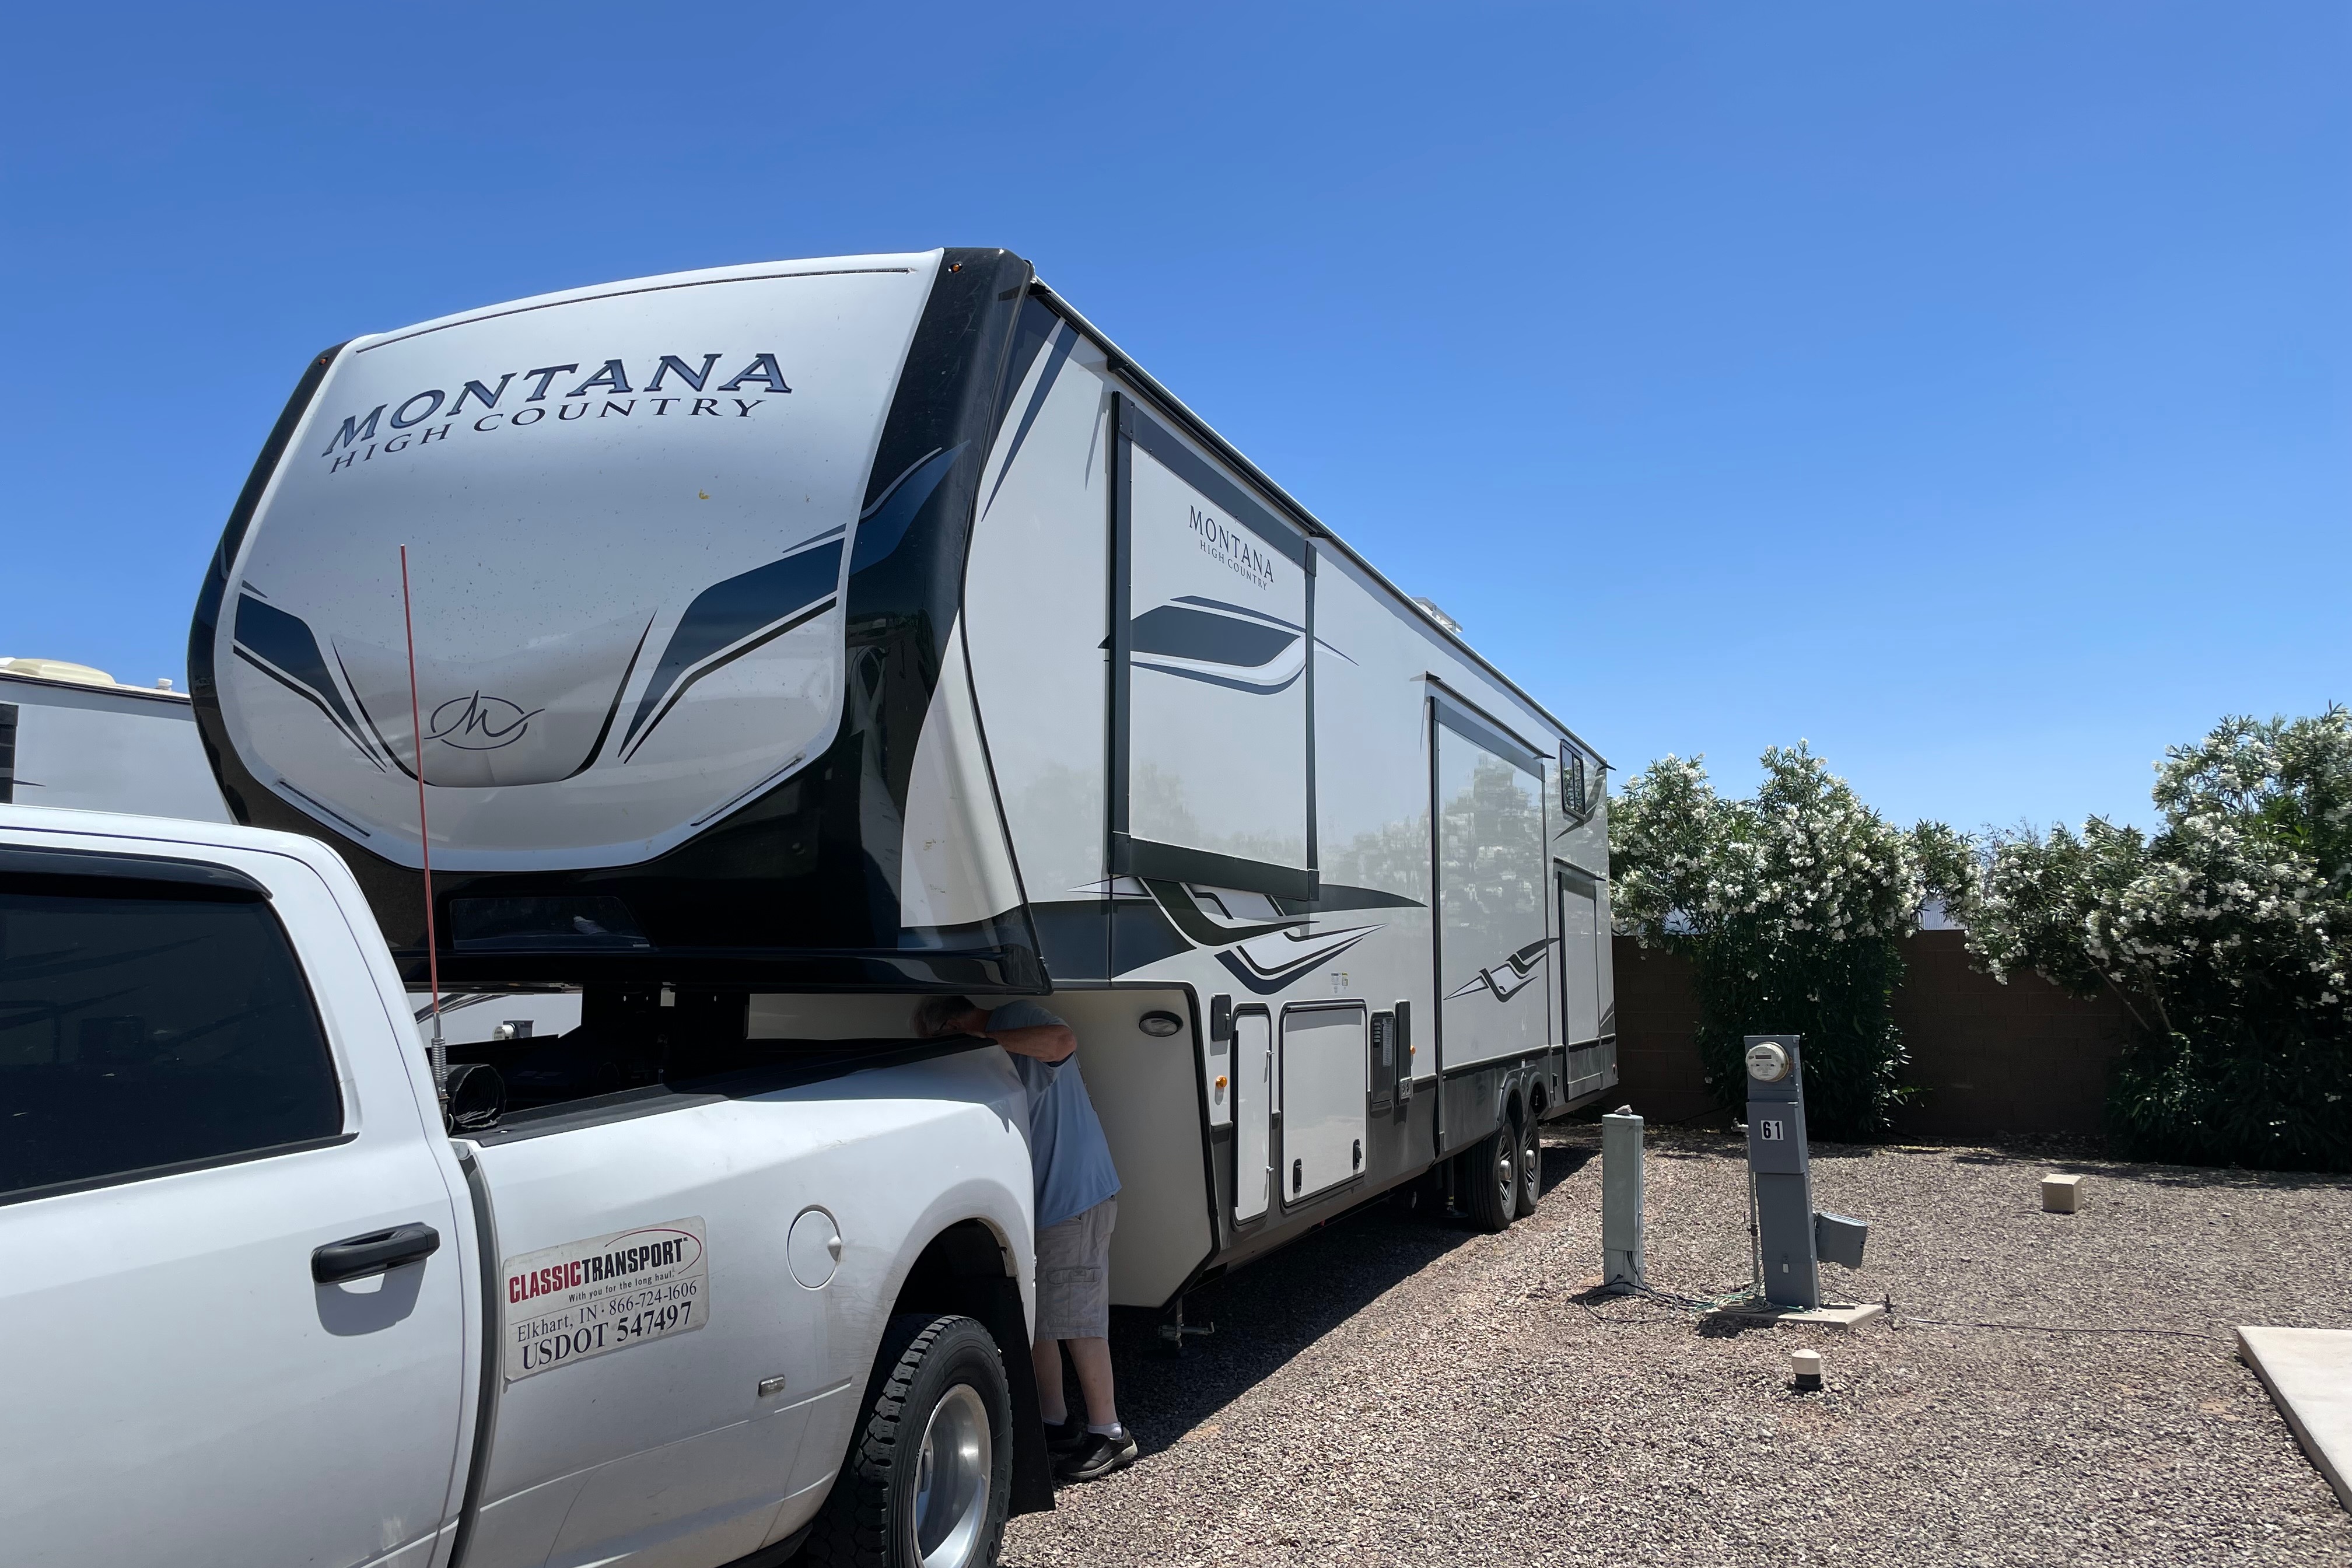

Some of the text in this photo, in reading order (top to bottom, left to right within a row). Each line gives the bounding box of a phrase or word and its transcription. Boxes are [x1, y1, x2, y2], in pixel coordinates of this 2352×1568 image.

[321, 353, 793, 457] MONTANA
[330, 398, 767, 474] HIGH COUNTRY
[1189, 505, 1274, 583] MONTANA
[1200, 540, 1268, 590] HIGH COUNTRY
[1763, 1121, 1781, 1139] 61
[517, 1280, 697, 1342] Elkhart, IN 866-724-1606
[568, 1293, 586, 1303] With
[589, 1288, 603, 1300] you
[606, 1284, 616, 1294] for
[620, 1281, 632, 1290] the
[635, 1278, 652, 1286] long
[522, 1300, 692, 1370] USDOT 547497
